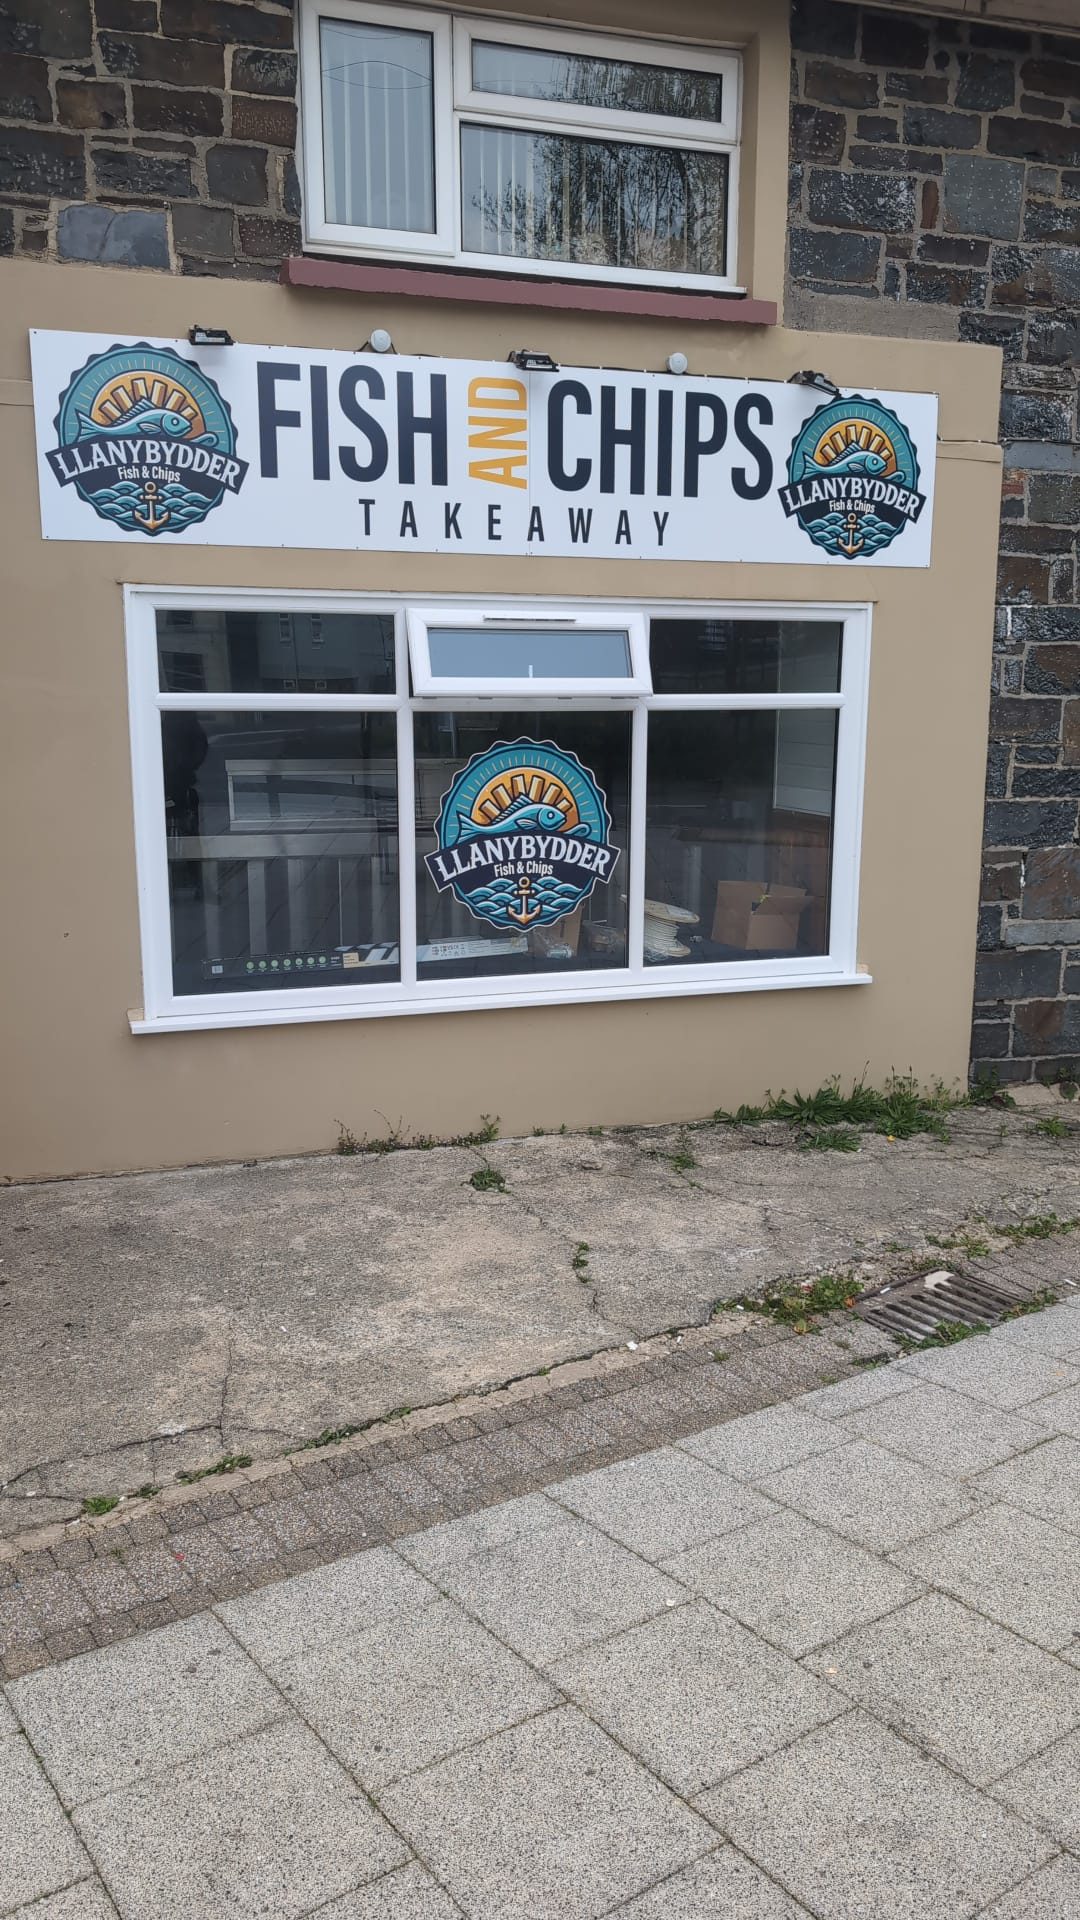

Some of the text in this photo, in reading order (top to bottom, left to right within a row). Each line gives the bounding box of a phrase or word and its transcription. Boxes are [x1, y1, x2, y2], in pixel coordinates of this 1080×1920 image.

[257, 360, 774, 501] FISH AND CHIPS
[54, 439, 242, 489] LLANYBYDDER
[117, 465, 181, 483] Fish & Chips
[784, 477, 921, 519] LLANYBYDDER
[829, 499, 876, 514] Fish & Chips
[358, 498, 670, 547] TAKEAWAY
[434, 835, 611, 882] LLANYBYDDER
[494, 860, 554, 878] Fish & Chips
